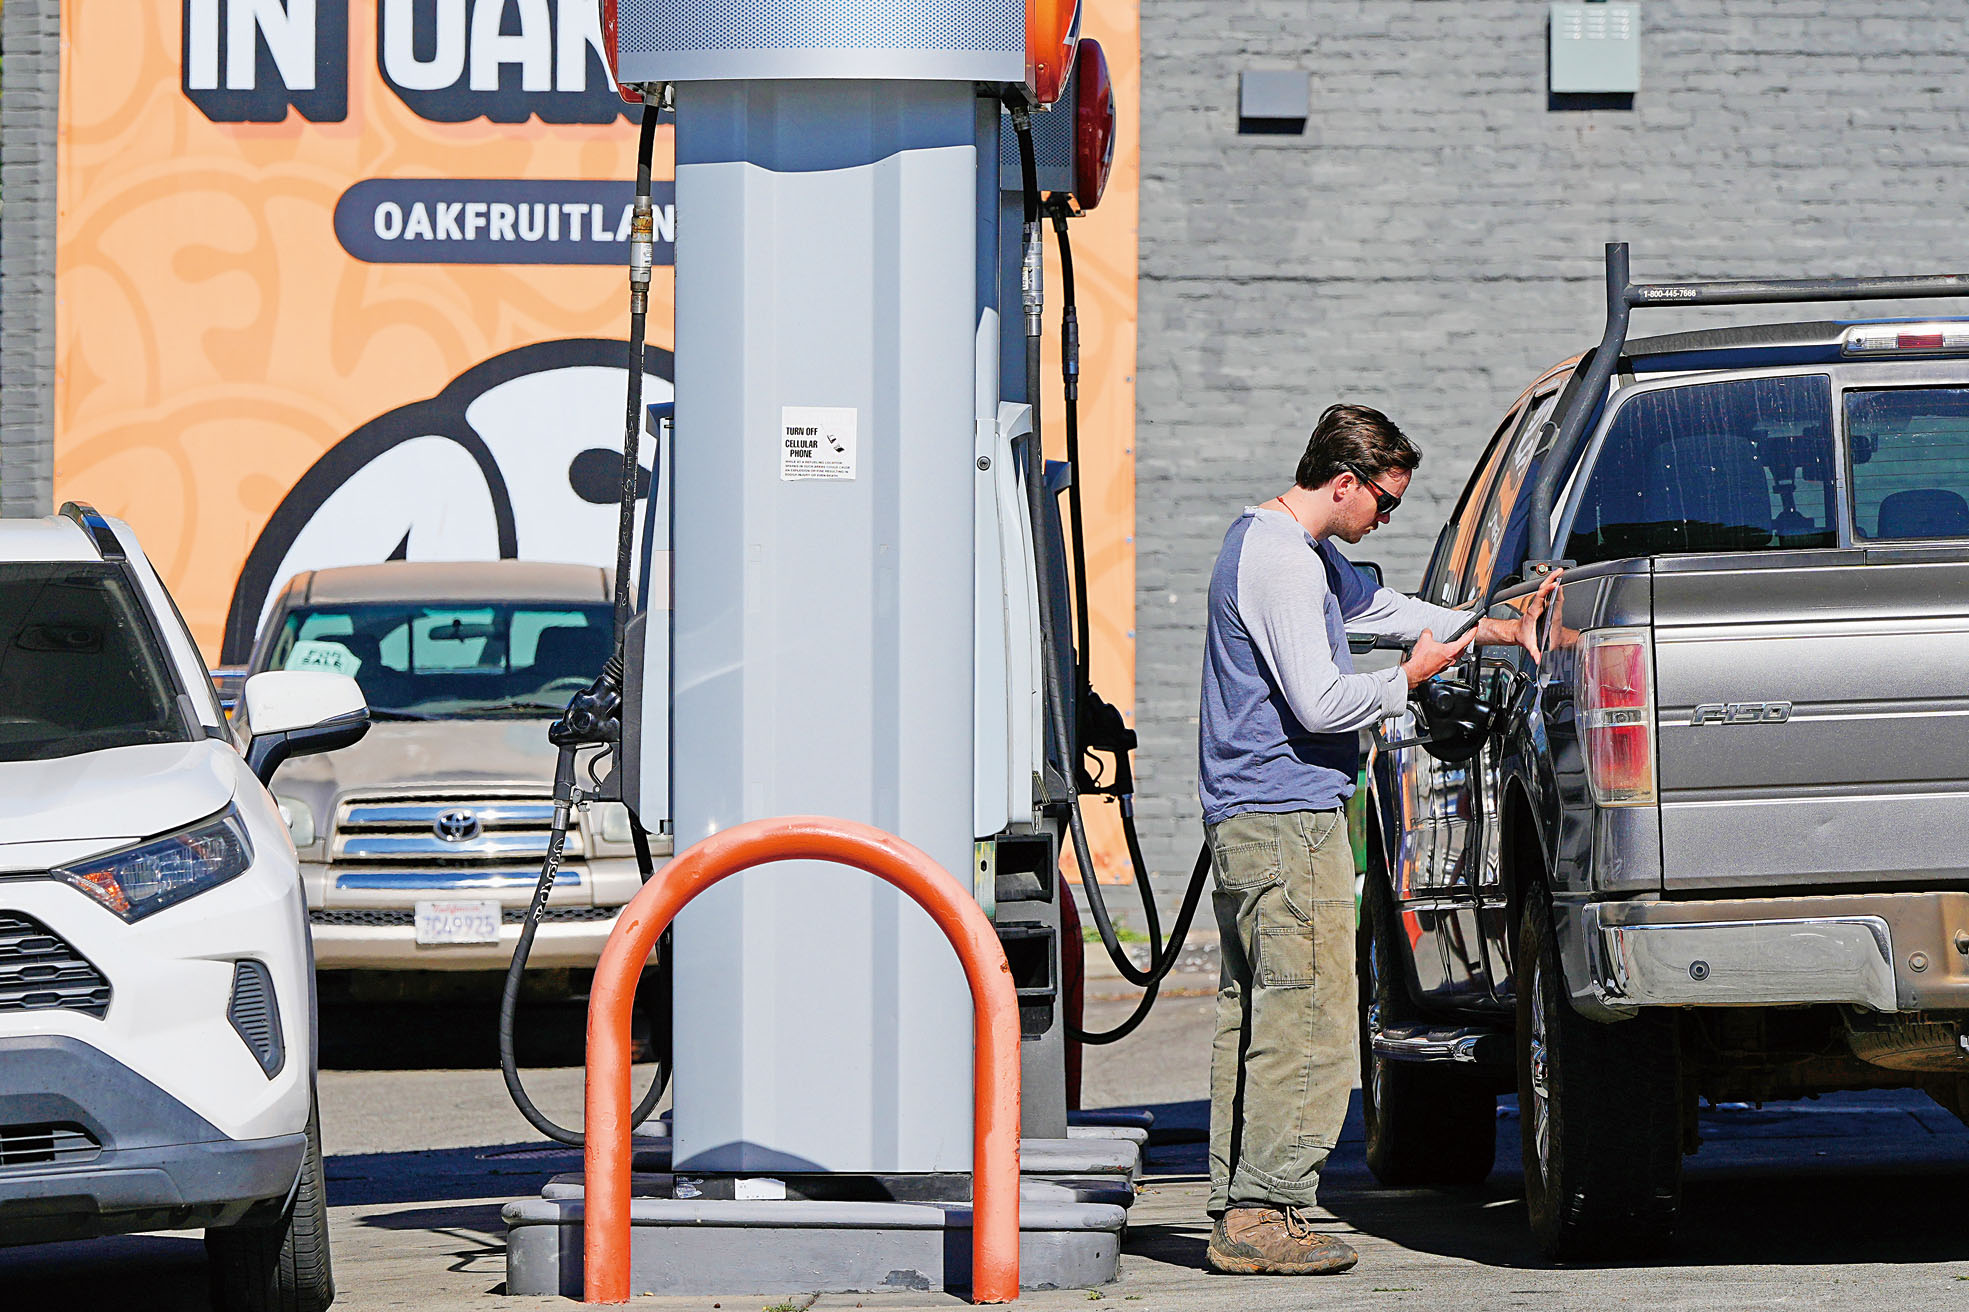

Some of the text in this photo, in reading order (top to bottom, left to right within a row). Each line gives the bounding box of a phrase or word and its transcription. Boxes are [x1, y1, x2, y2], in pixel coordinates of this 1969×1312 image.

[188, 0, 317, 92] IN
[786, 426, 818, 436] TURN OFF
[784, 439, 818, 448] CELLULAR
[790, 449, 812, 458] PHONE
[302, 657, 342, 668] SALE
